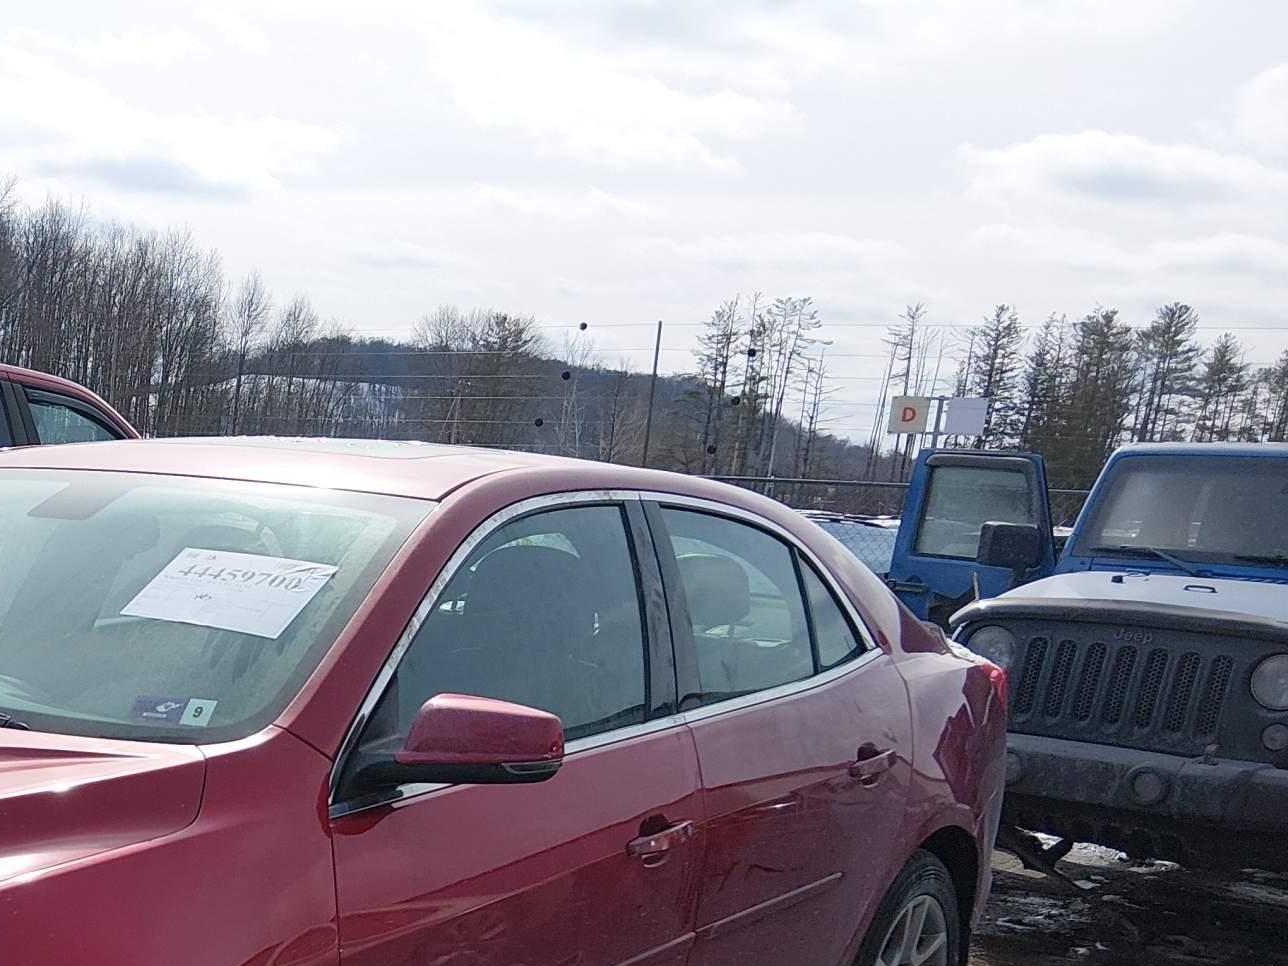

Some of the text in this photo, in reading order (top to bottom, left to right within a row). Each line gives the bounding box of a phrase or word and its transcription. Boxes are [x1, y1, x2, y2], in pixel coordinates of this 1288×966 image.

[901, 407, 916, 422] D
[178, 563, 303, 591] 44459700
[1113, 627, 1153, 645] Jeep
[192, 706, 204, 718] 9
